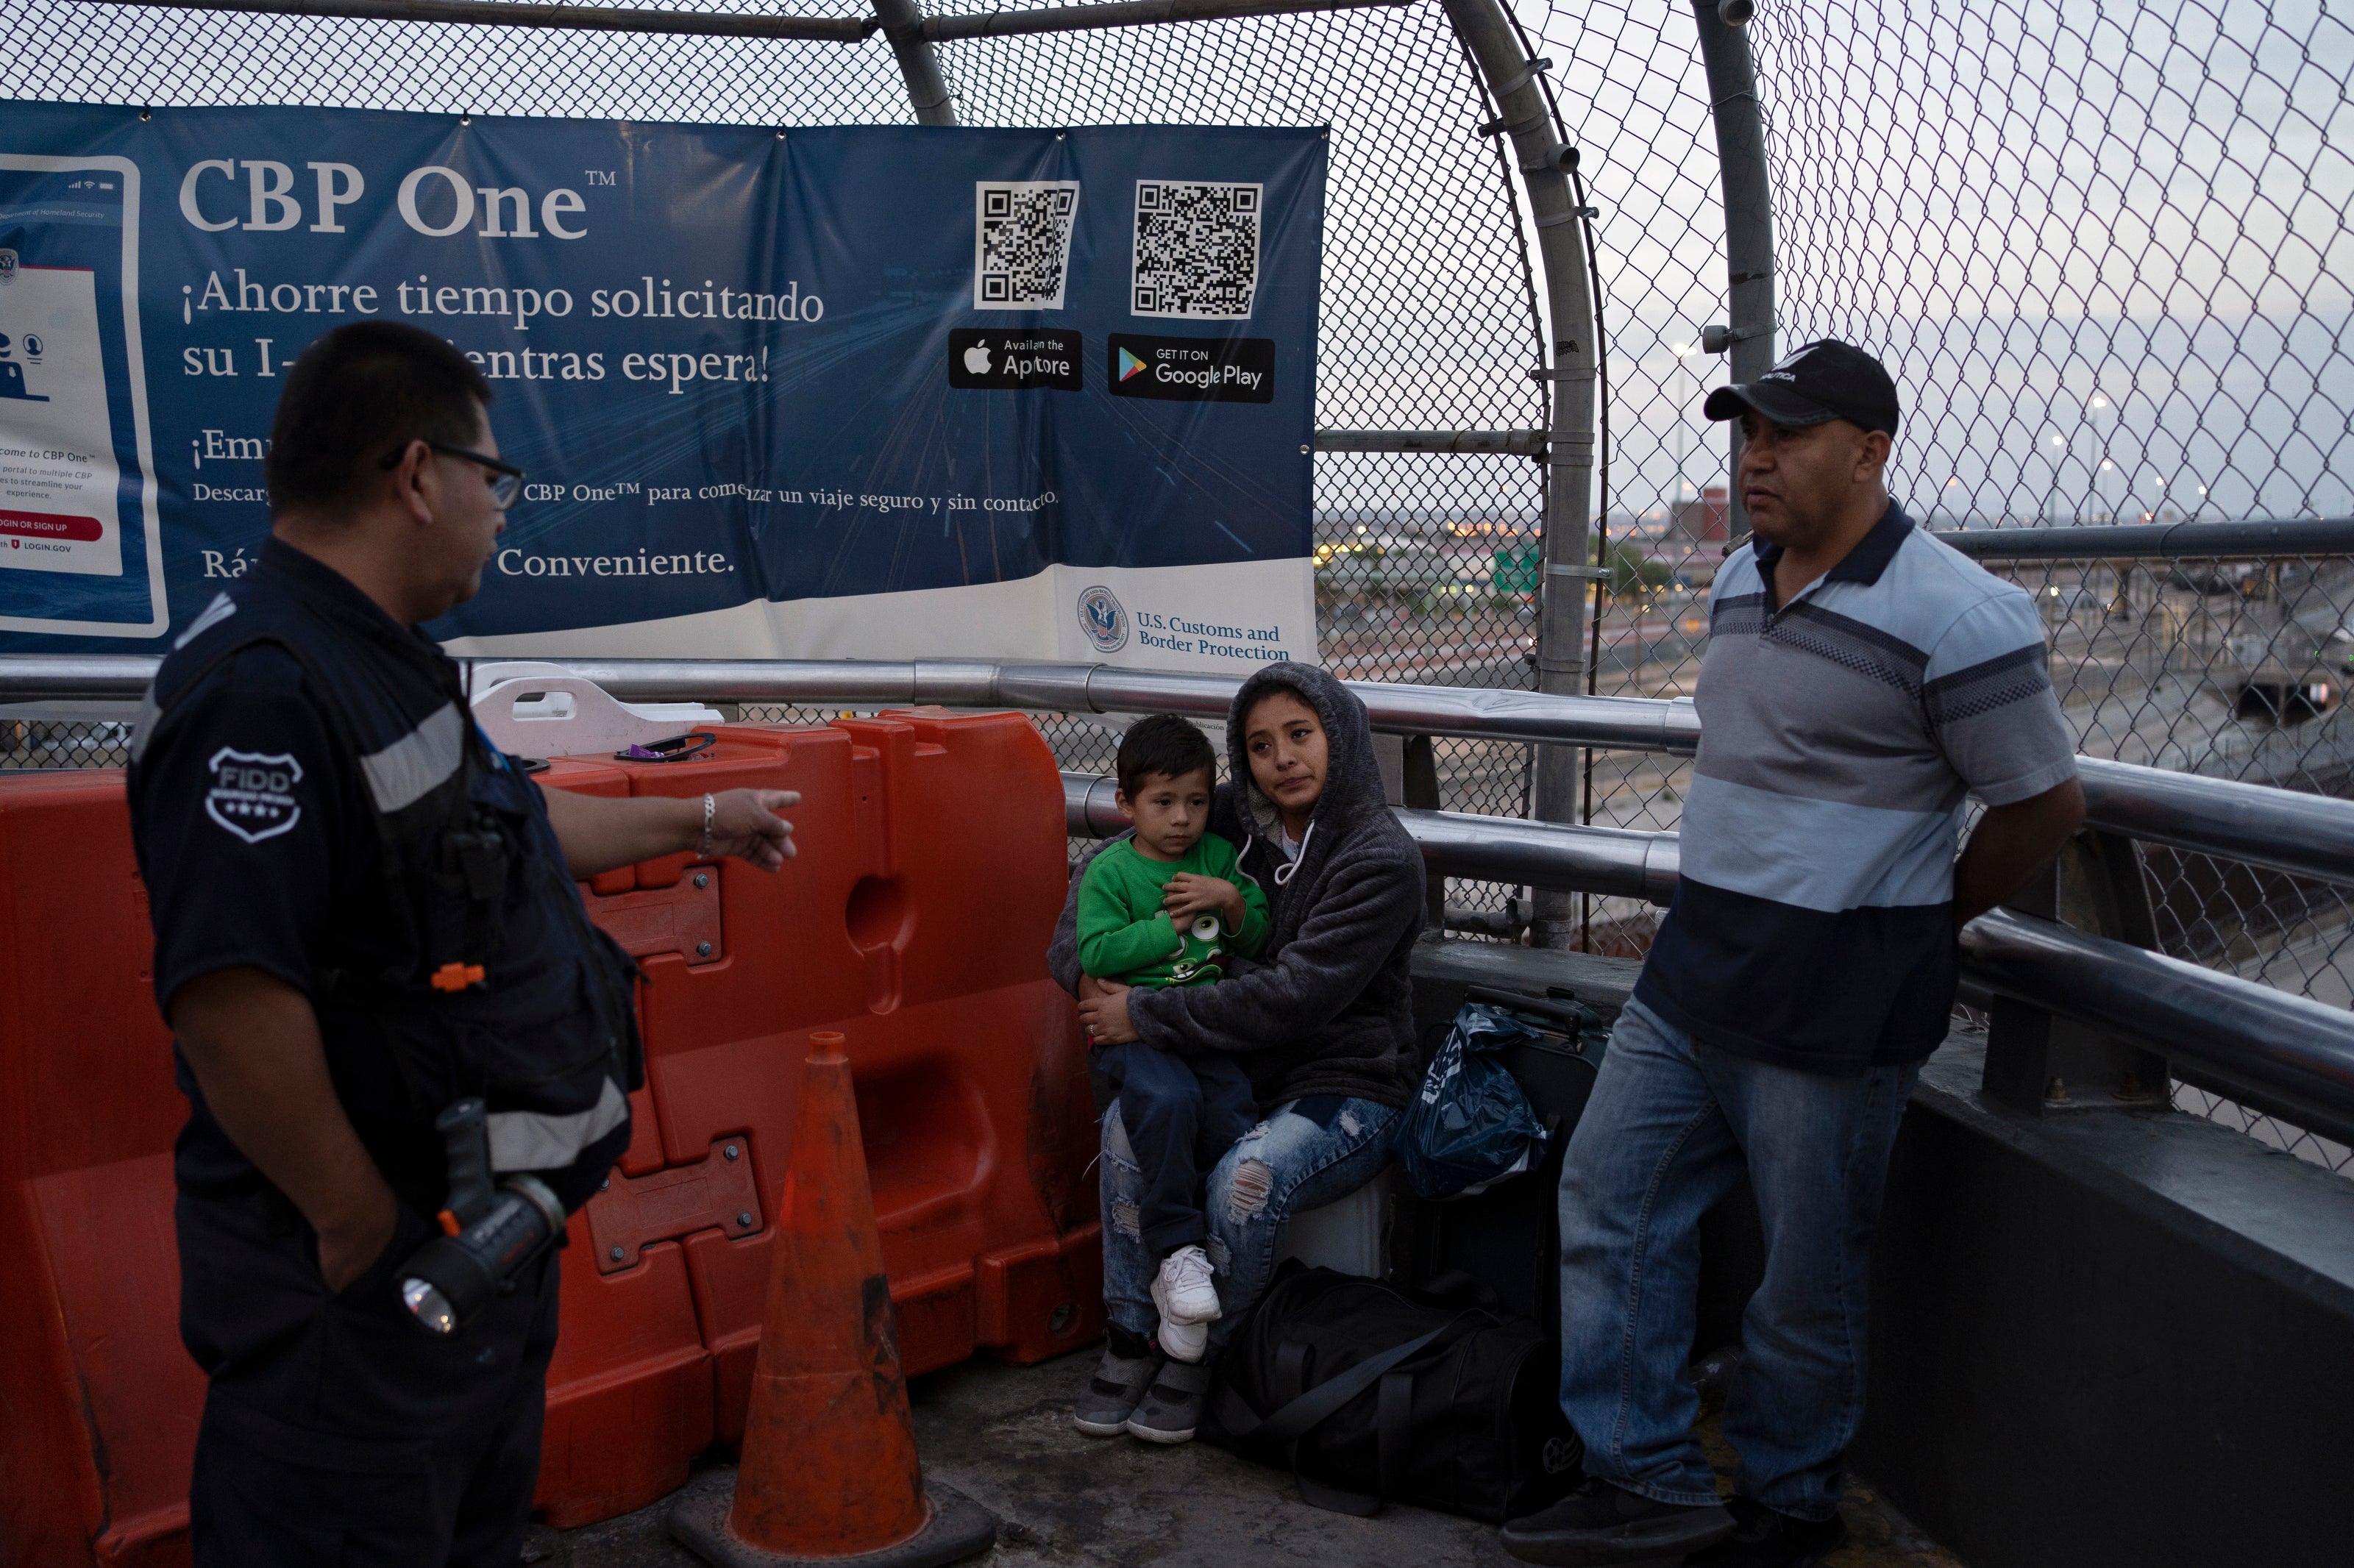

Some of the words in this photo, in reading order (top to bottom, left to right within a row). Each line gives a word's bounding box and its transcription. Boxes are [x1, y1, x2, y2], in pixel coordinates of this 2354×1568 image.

[179, 158, 365, 232] CBP
[40, 209, 75, 217] Homeland
[77, 210, 104, 219] Security
[182, 268, 379, 324] ¡Ahorre
[397, 274, 573, 329] tiempo
[591, 277, 824, 322] solicitando
[1048, 339, 1064, 351] the
[1156, 349, 1177, 360] GET
[1179, 350, 1189, 360] IT
[1191, 350, 1208, 360] ON
[183, 347, 238, 376] su
[622, 346, 768, 393] espera!
[1156, 363, 1220, 388] Google
[1223, 366, 1262, 390] Play
[29, 449, 40, 458] to
[43, 450, 64, 460] CBP
[192, 430, 272, 470] ¡Em
[2, 466, 26, 474] portal
[40, 469, 73, 478] multiple
[75, 471, 92, 480] CBP
[7, 489, 51, 499] experience.
[21, 479, 63, 489] streamline
[524, 484, 566, 502] CBP
[647, 487, 691, 505] para
[699, 483, 772, 502] comenzar
[778, 491, 803, 503] un
[809, 488, 853, 510] viaje
[860, 496, 923, 512] seguro
[930, 497, 941, 514] y
[948, 493, 977, 510] sin
[984, 492, 1058, 511] contacto.
[20, 521, 32, 529] OR
[34, 522, 54, 530] SIGN
[56, 524, 67, 532] UP
[24, 543, 71, 552] LOGIN.GOV
[202, 549, 259, 578] Rá
[497, 548, 735, 576] Conveniente.
[1137, 612, 1166, 630] U.S.
[1170, 617, 1242, 640] Customs
[1248, 626, 1280, 641] and
[1139, 630, 1192, 652] Border
[1198, 639, 1290, 661] Protection
